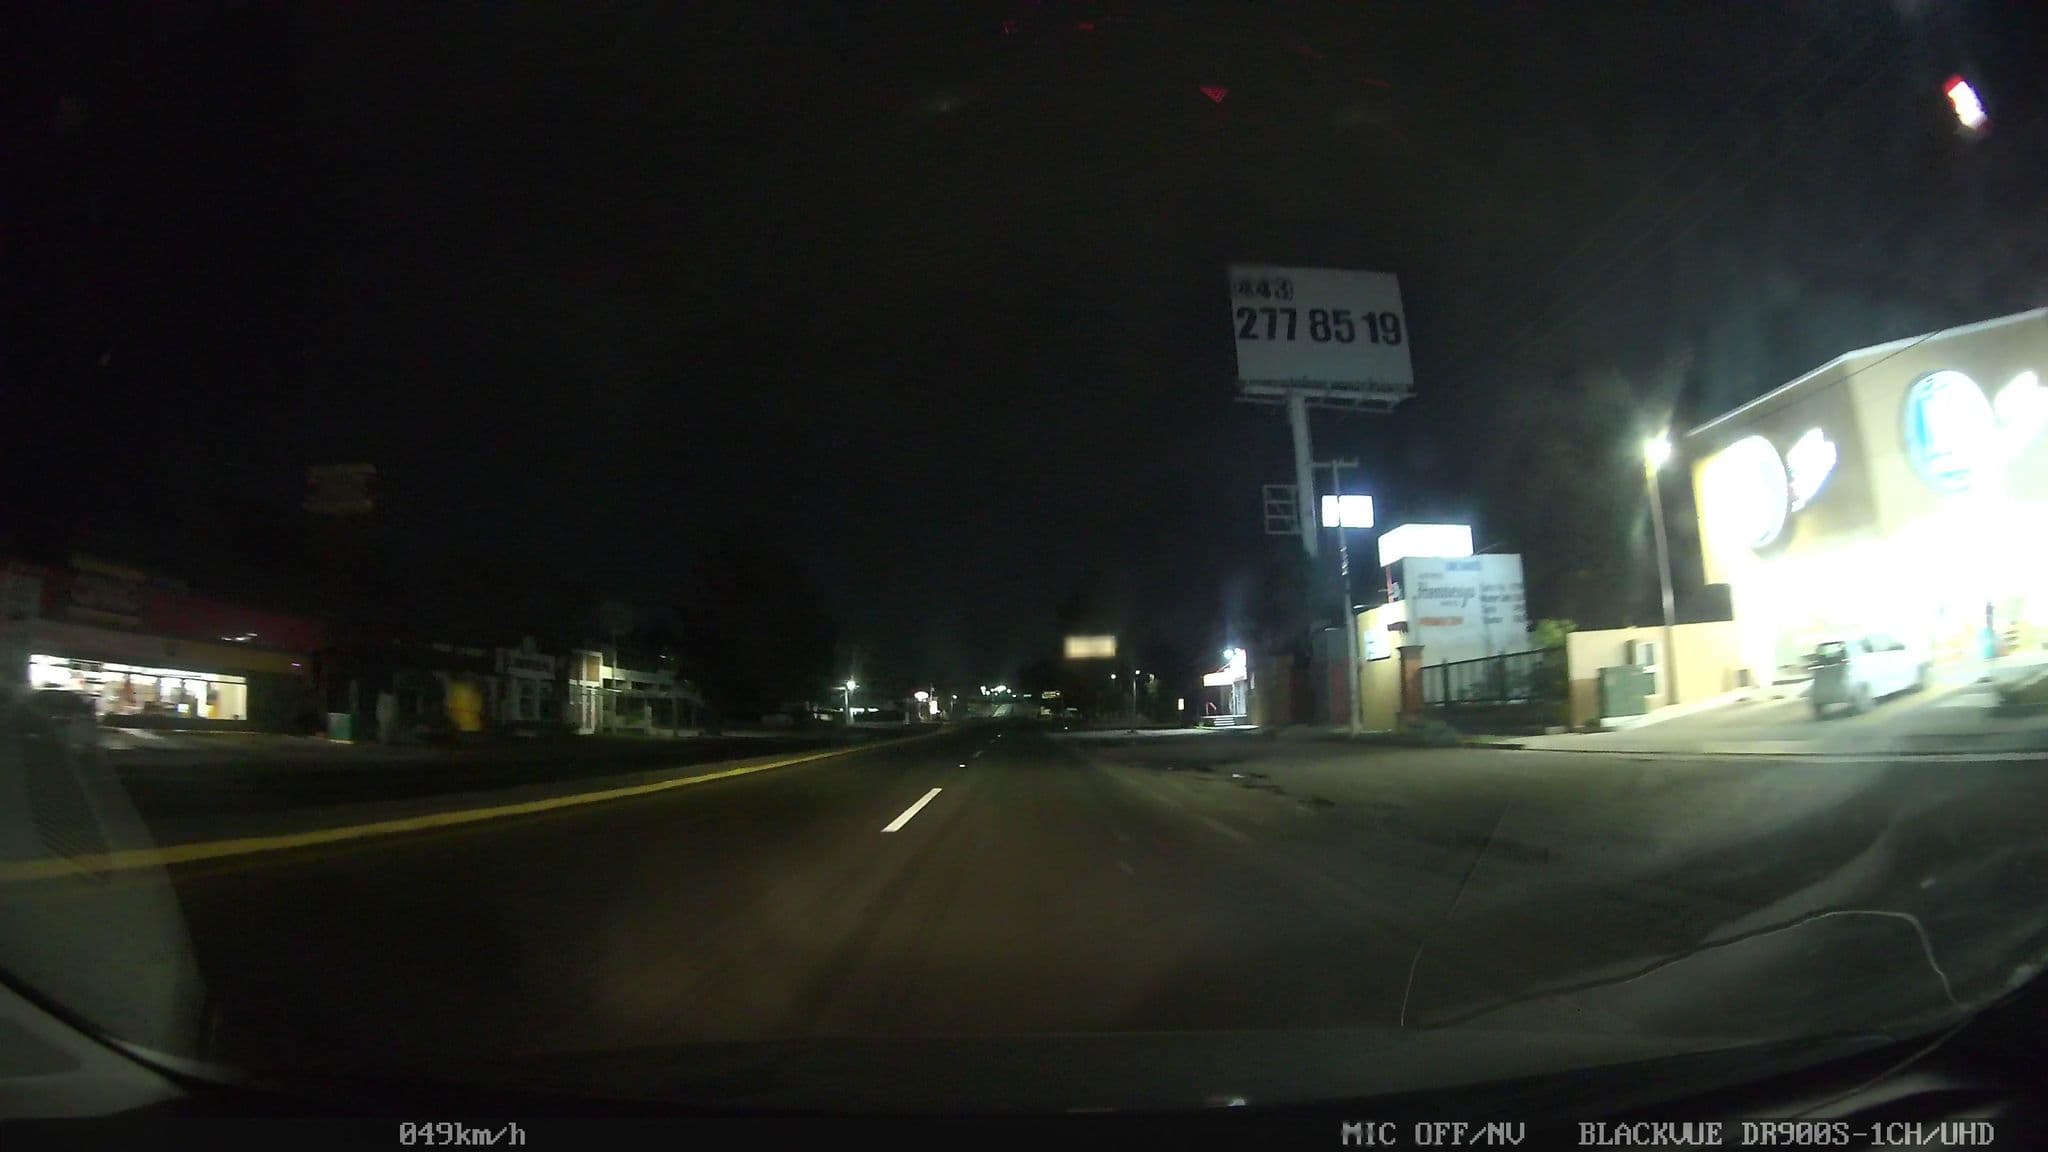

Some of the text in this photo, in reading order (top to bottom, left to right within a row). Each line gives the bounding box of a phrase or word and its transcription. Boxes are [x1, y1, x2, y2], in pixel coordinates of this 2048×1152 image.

[1236, 306, 1402, 346] 277 85 19
